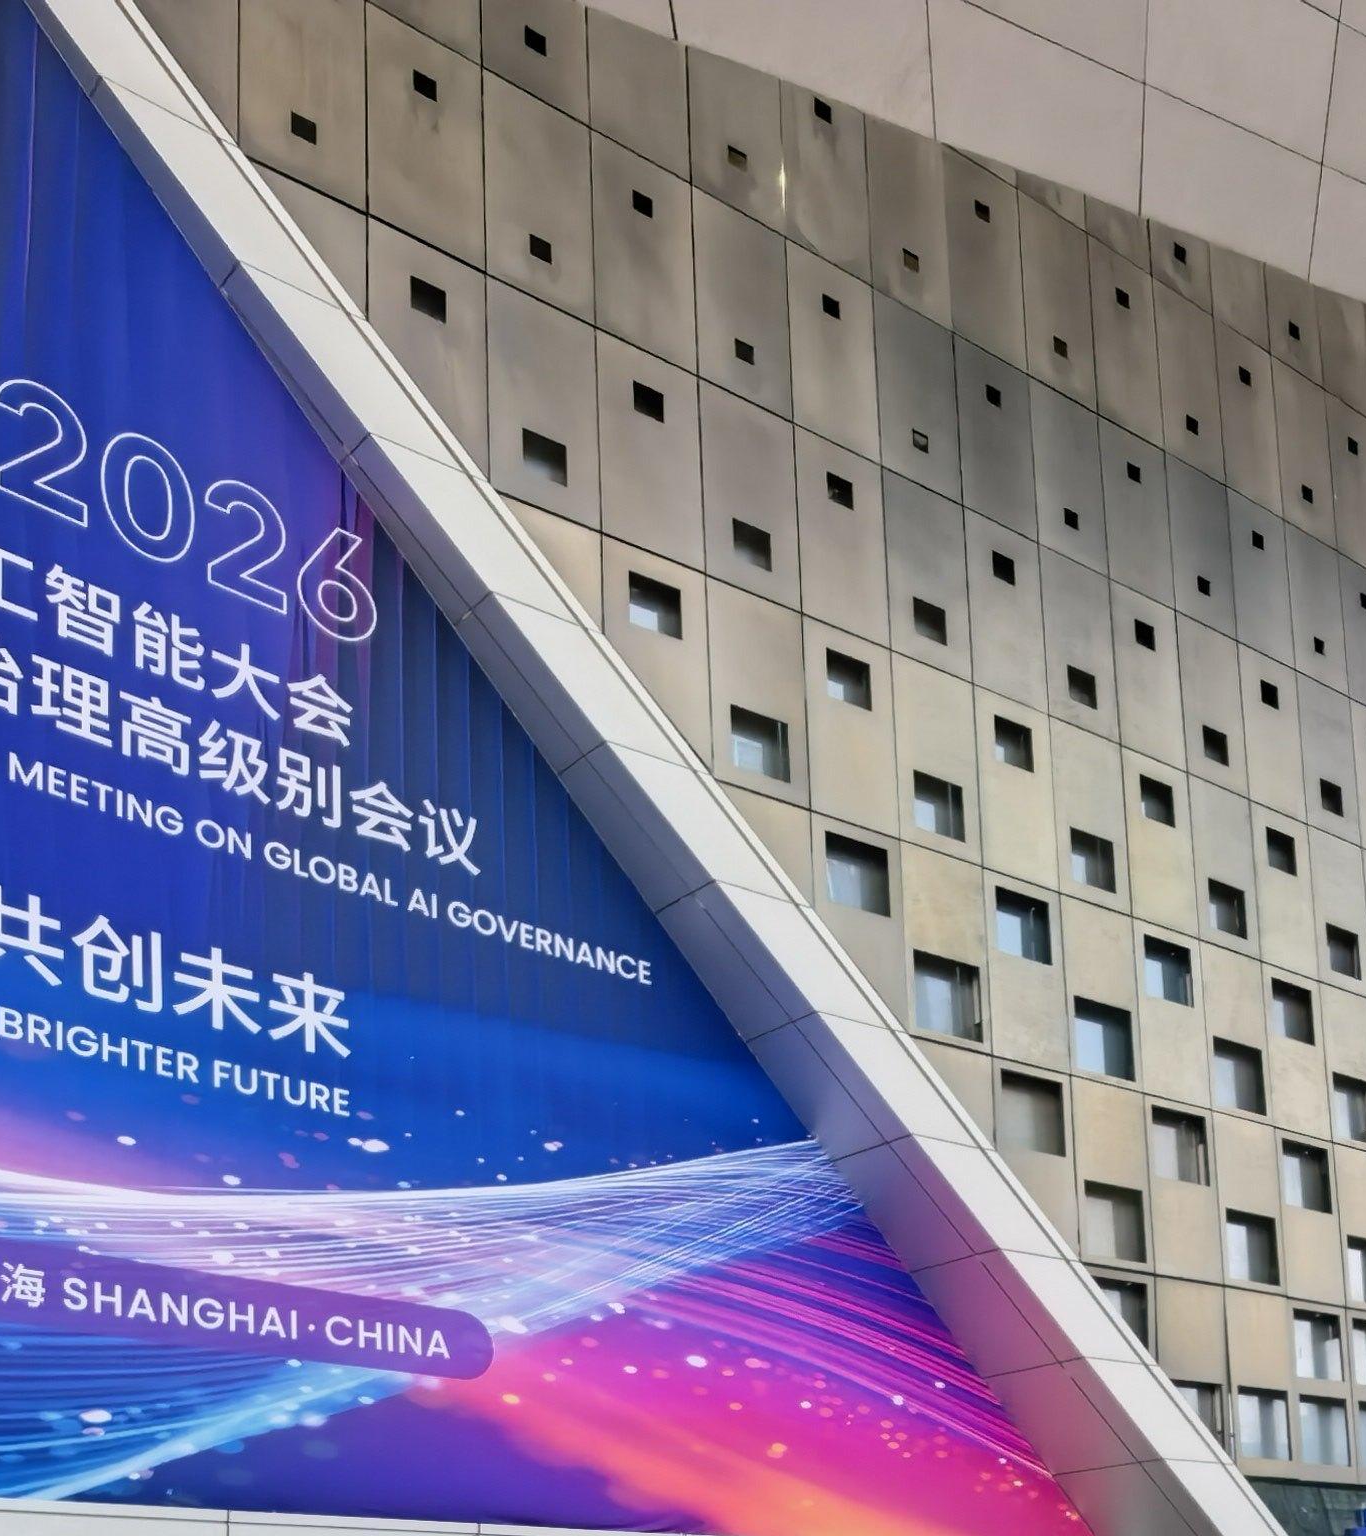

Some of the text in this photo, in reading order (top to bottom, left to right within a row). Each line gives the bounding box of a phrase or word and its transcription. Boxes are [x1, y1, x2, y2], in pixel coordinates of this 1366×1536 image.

[10, 752, 183, 835] MEETING
[196, 820, 251, 859] ON
[264, 842, 398, 906] GLOBAL
[408, 889, 437, 918] AI
[448, 902, 651, 984] GOVERNANCE
[0, 1007, 198, 1082] BRIGHTER
[214, 1061, 349, 1116] FUTURE
